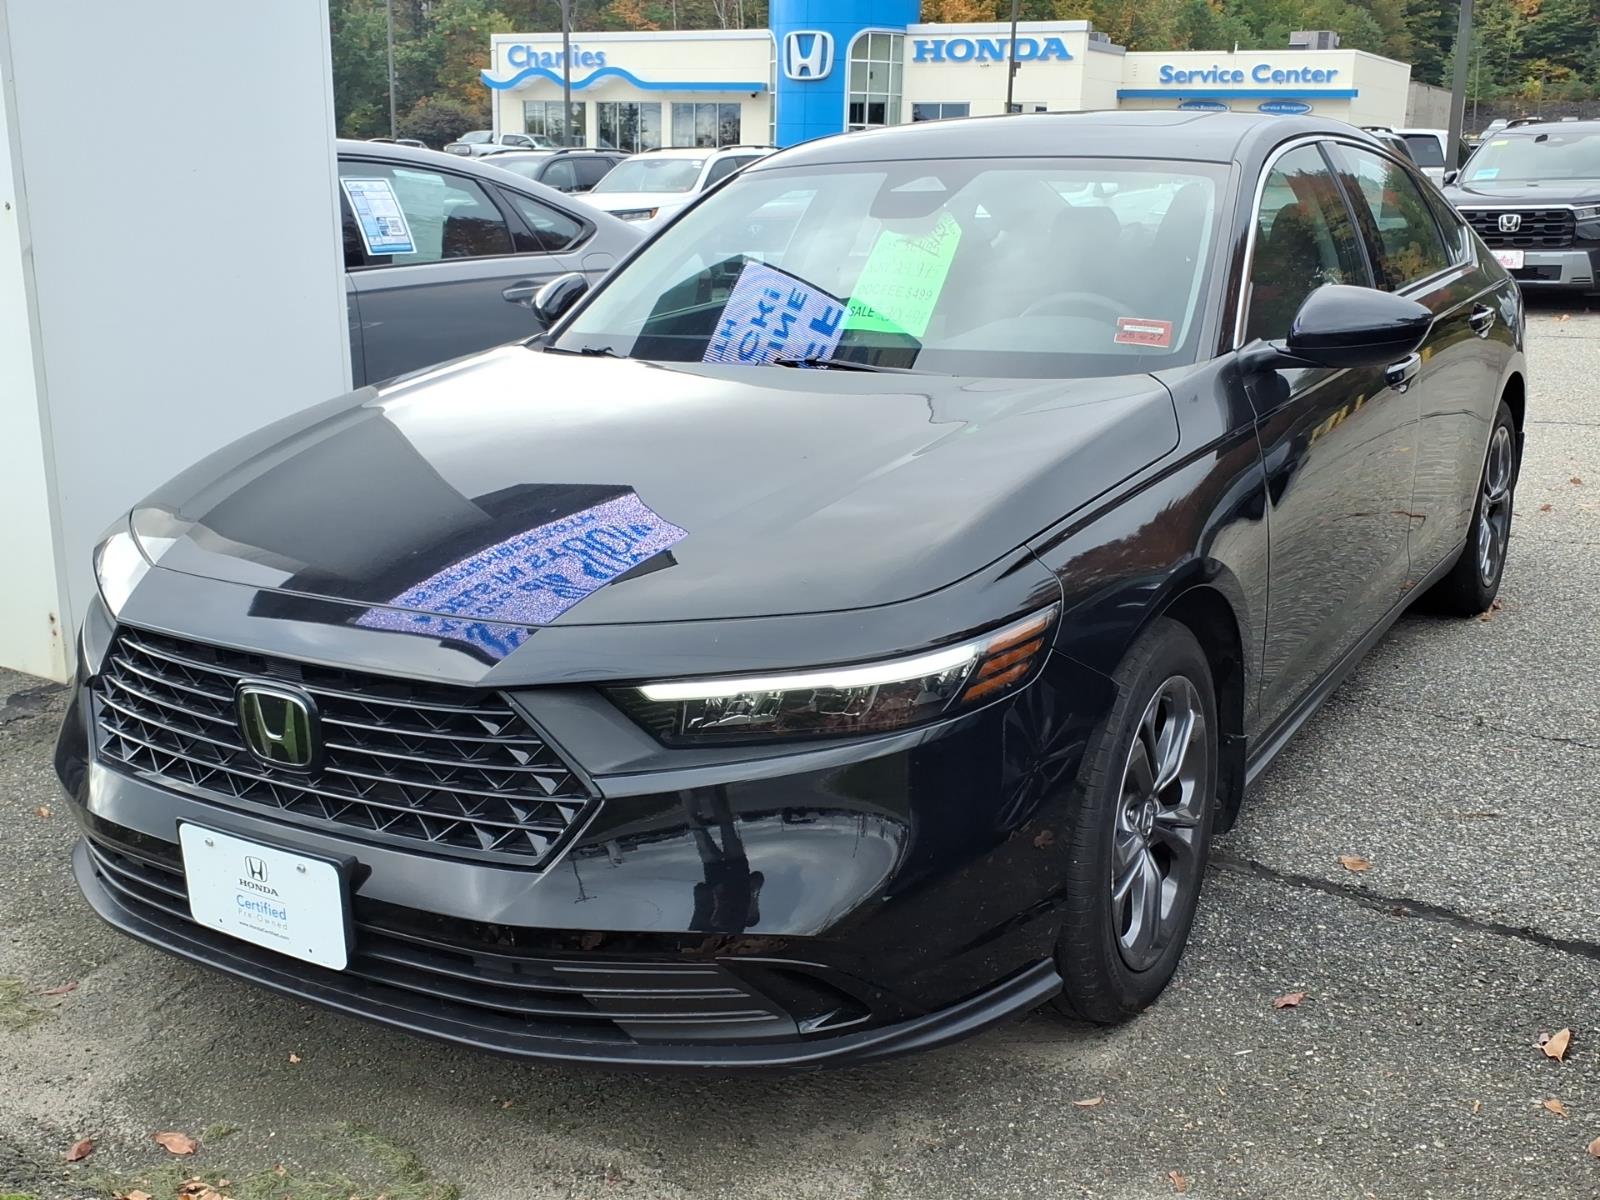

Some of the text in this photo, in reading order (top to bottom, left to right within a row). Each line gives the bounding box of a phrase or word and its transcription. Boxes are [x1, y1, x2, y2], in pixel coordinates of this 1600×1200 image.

[507, 44, 606, 69] Charlies
[912, 37, 1073, 63] HONDA
[1159, 64, 1339, 85] Service Center
[849, 305, 875, 319] SALE
[239, 878, 279, 897] HONDA
[236, 894, 286, 921] Certified
